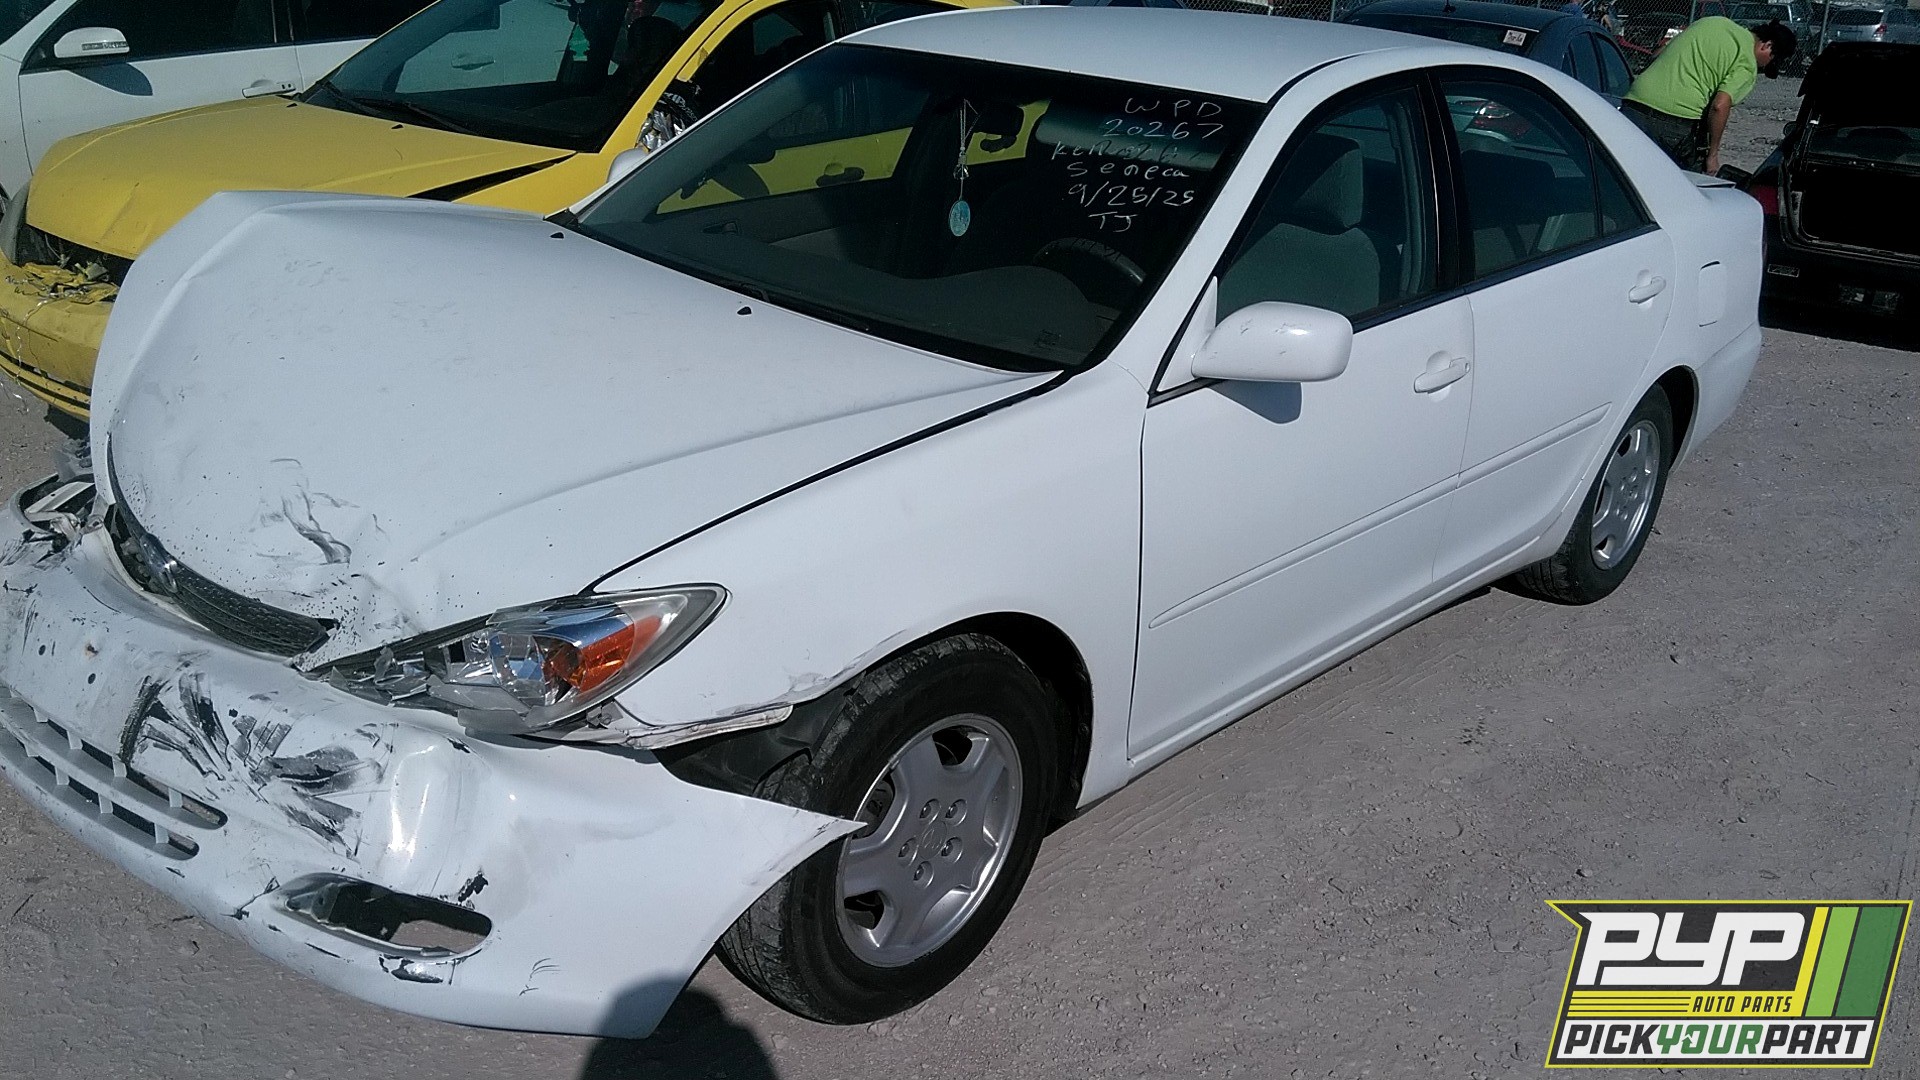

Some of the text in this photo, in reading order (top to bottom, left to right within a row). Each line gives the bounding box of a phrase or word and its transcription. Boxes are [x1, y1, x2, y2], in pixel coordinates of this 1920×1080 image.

[1102, 118, 1225, 140] 20267
[1066, 161, 1191, 180] Seneca
[1067, 181, 1196, 208] 9/25/25
[1088, 211, 1139, 233] TJ
